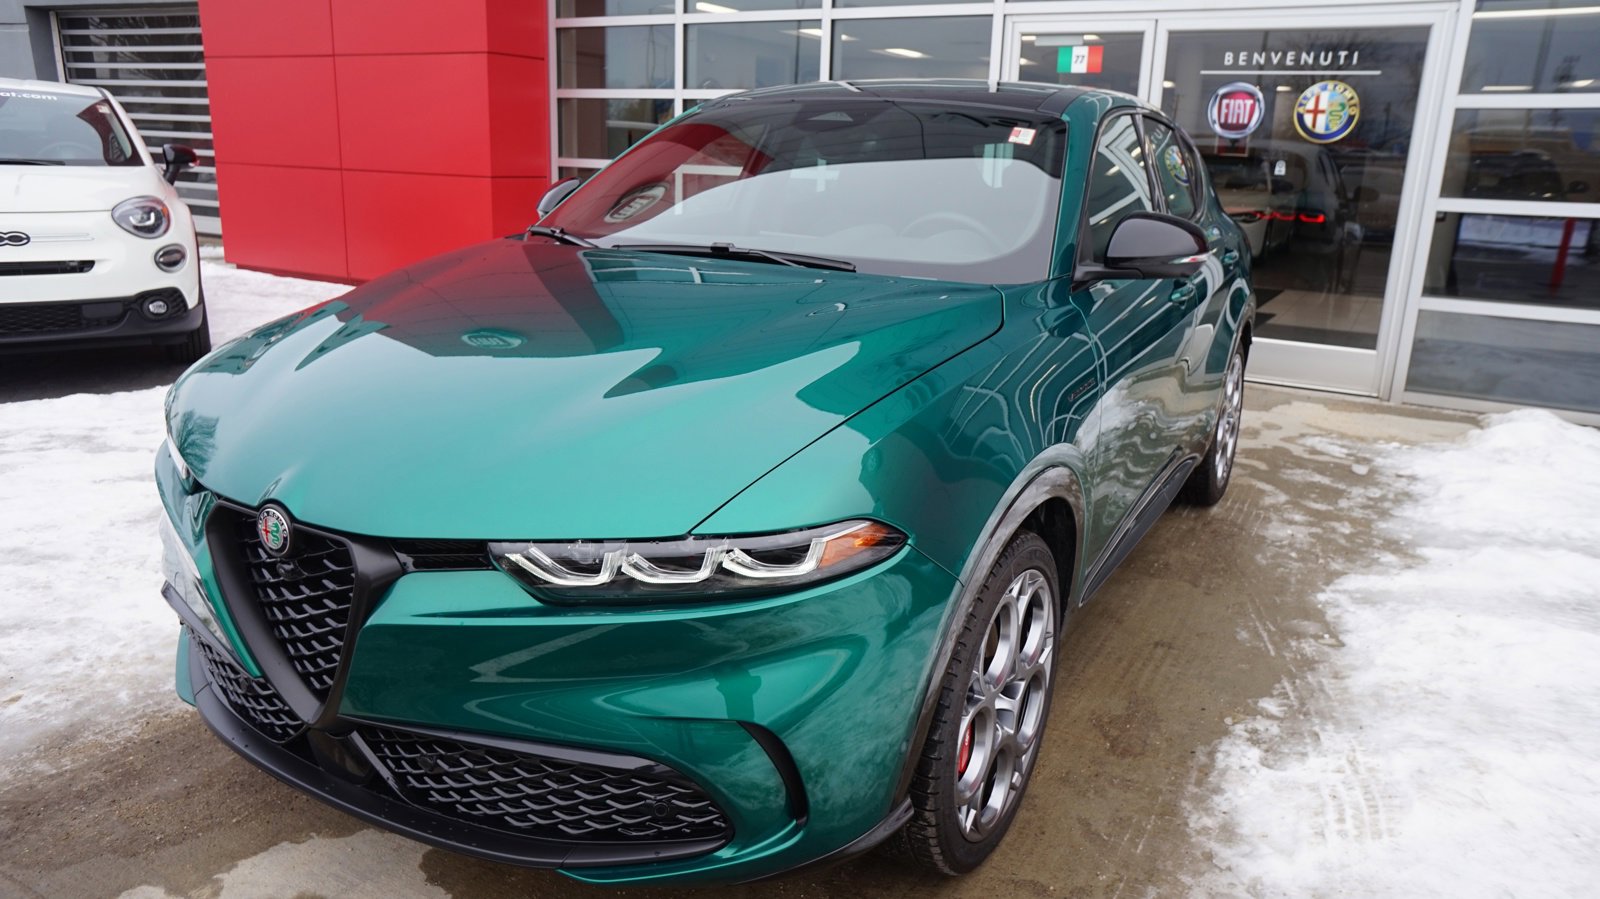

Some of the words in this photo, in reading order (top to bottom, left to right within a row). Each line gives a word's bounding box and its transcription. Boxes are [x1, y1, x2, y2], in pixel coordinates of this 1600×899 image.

[1224, 51, 1358, 65] BENVENUTI
[1220, 98, 1254, 124] FIAT
[1328, 82, 1357, 115] ROMEO
